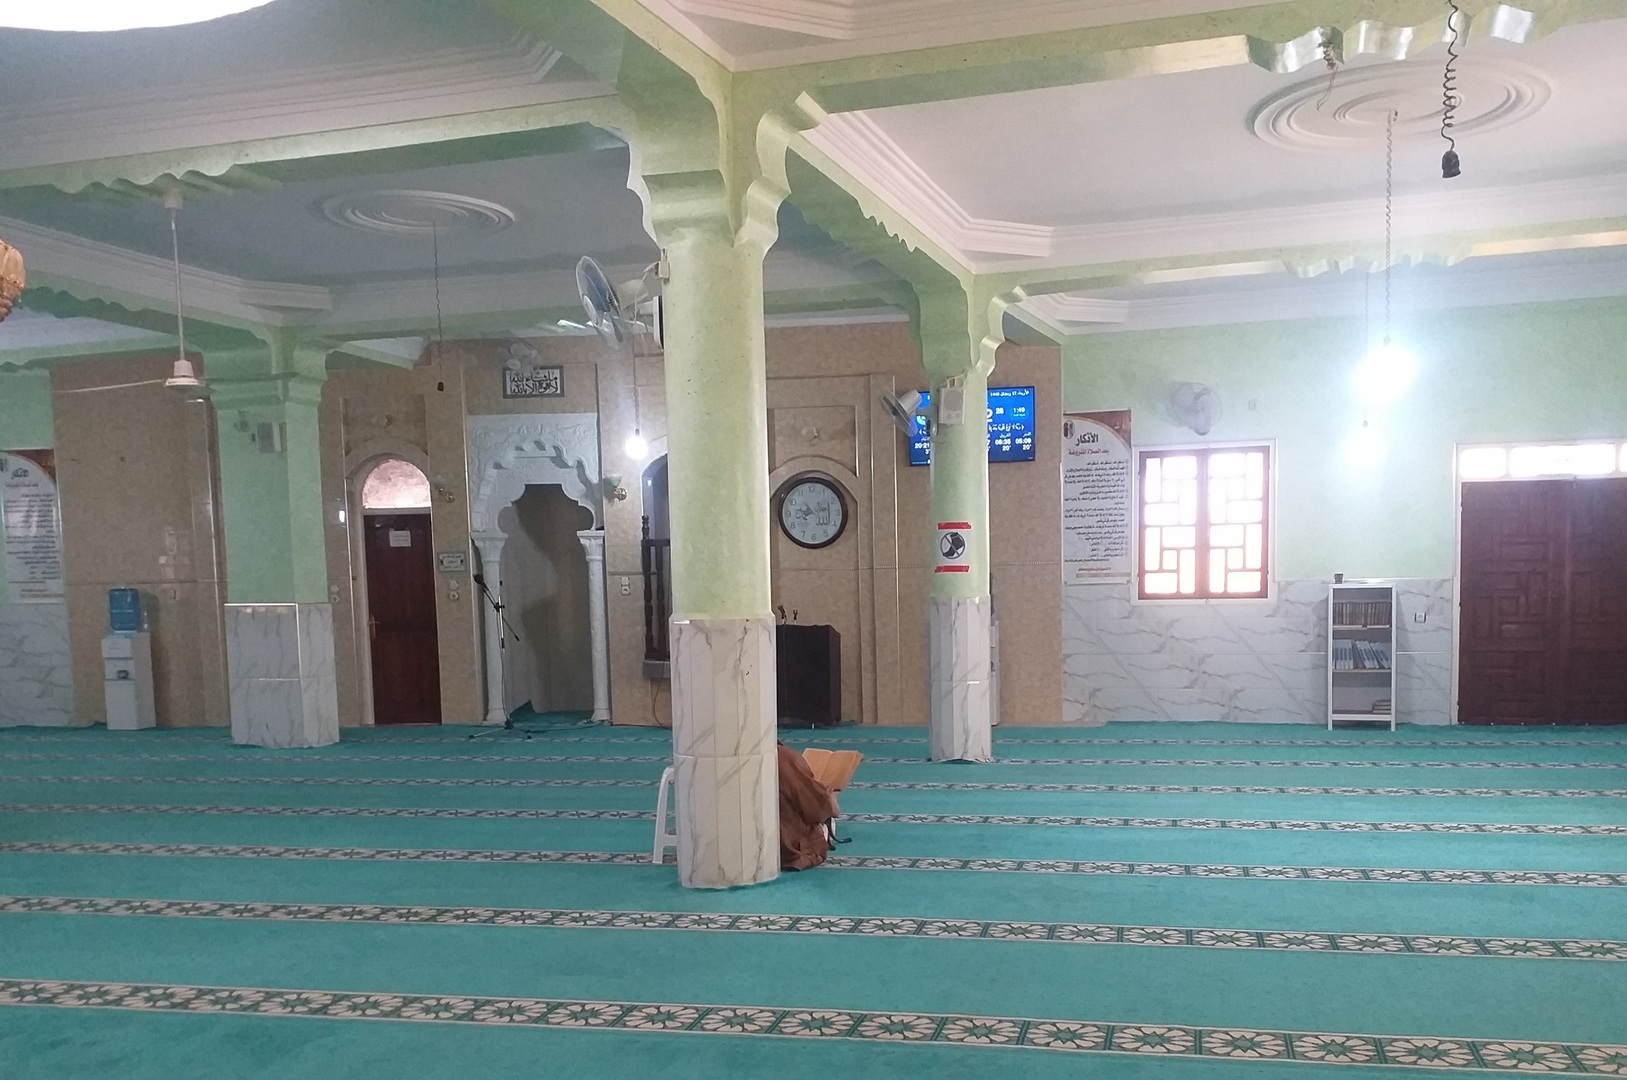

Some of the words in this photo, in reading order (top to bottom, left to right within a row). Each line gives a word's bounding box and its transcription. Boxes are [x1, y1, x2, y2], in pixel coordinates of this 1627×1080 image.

[808, 485, 816, 493] 12
[790, 498, 797, 506] 10
[785, 510, 791, 518] 9
[834, 509, 840, 517] 3
[790, 522, 796, 530] 8
[811, 533, 817, 541] 6
[823, 530, 829, 538] 5
